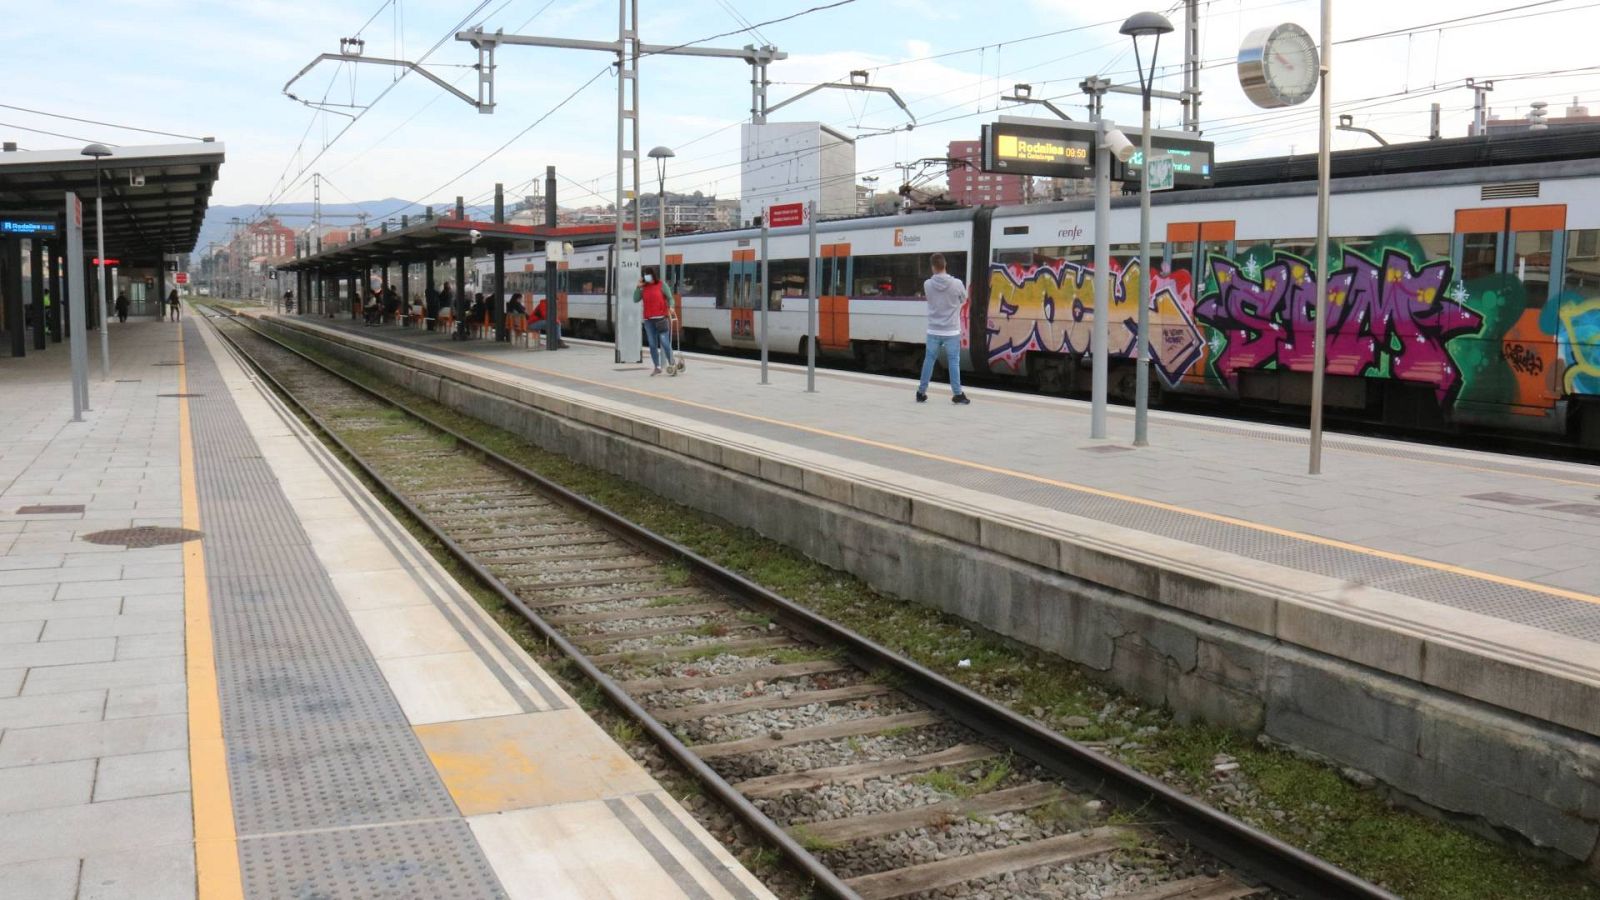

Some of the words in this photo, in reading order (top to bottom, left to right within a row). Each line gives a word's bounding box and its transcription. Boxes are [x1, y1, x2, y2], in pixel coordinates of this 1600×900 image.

[1018, 140, 1064, 155] Rodalies
[1065, 147, 1087, 158] 09:50
[1058, 225, 1083, 240] renfe
